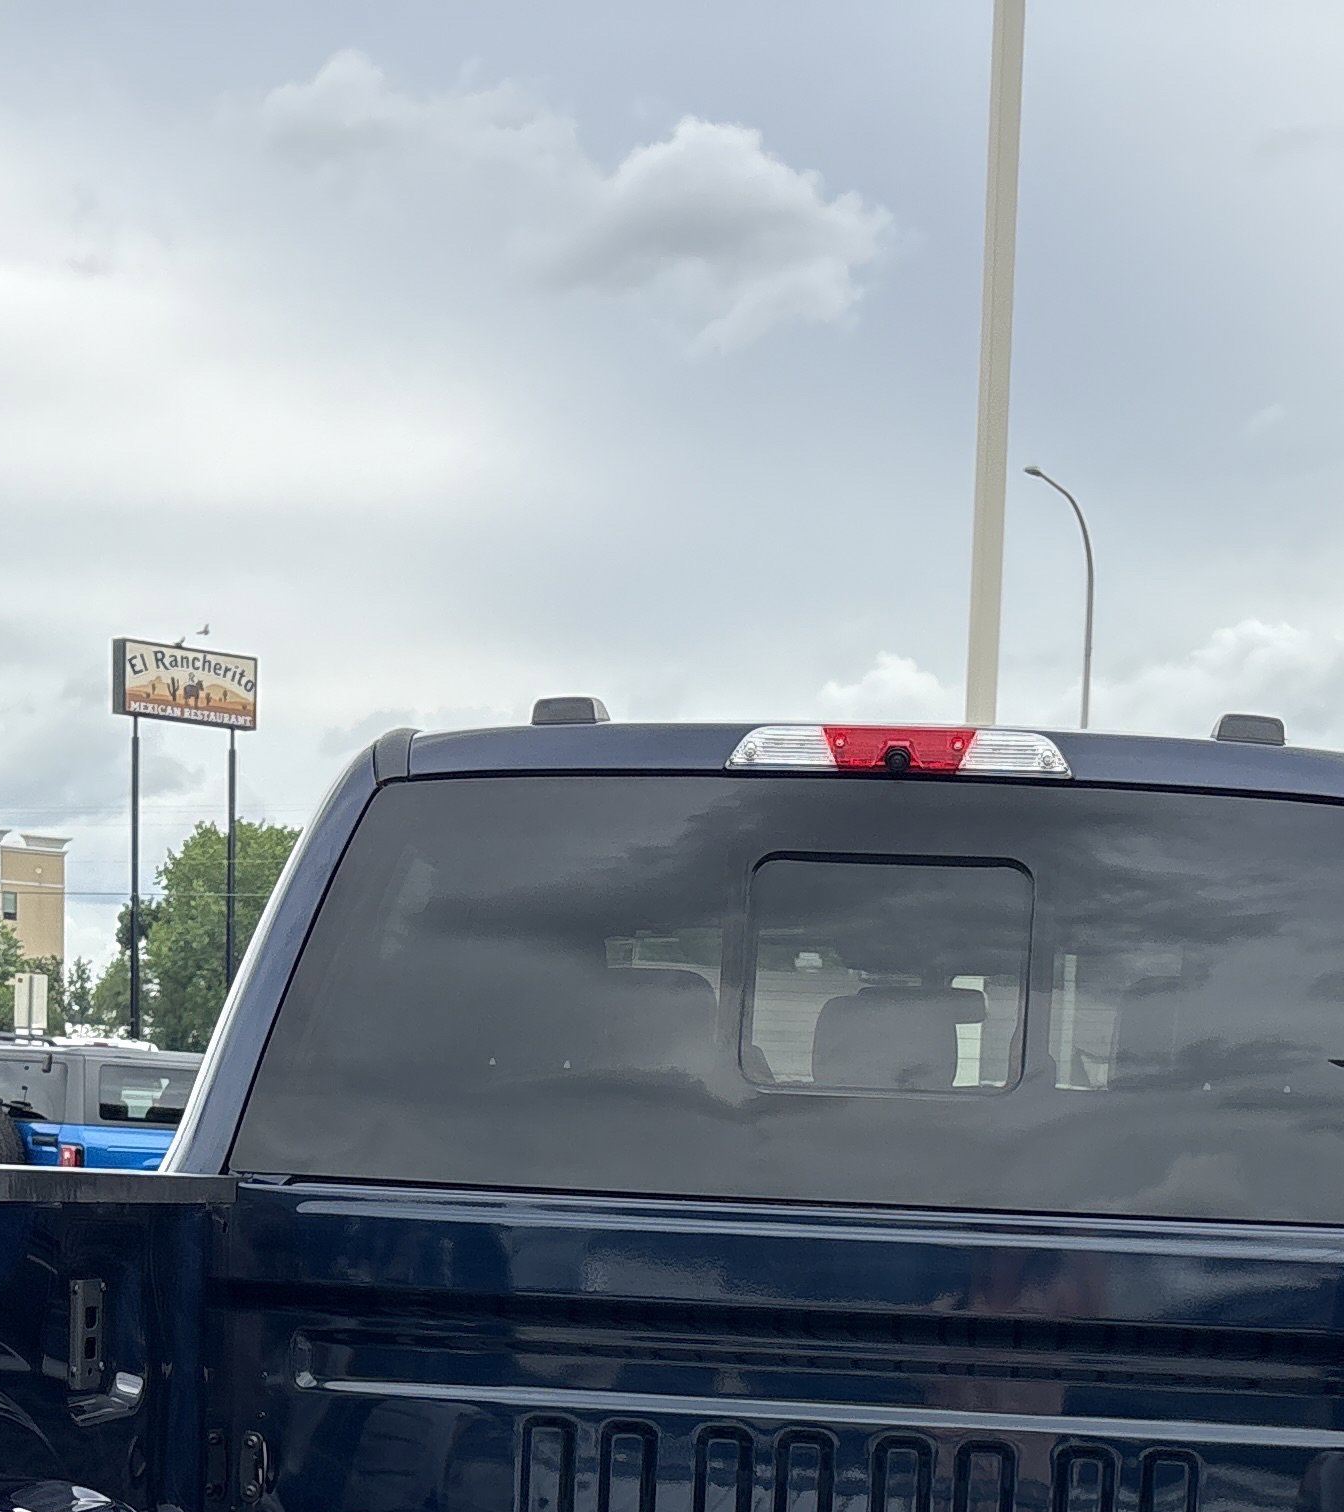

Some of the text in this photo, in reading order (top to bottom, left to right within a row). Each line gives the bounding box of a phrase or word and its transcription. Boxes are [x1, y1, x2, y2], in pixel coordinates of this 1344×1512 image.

[127, 650, 256, 692] El Rancherito
[129, 701, 254, 727] MEXICAN RESTAURANT
